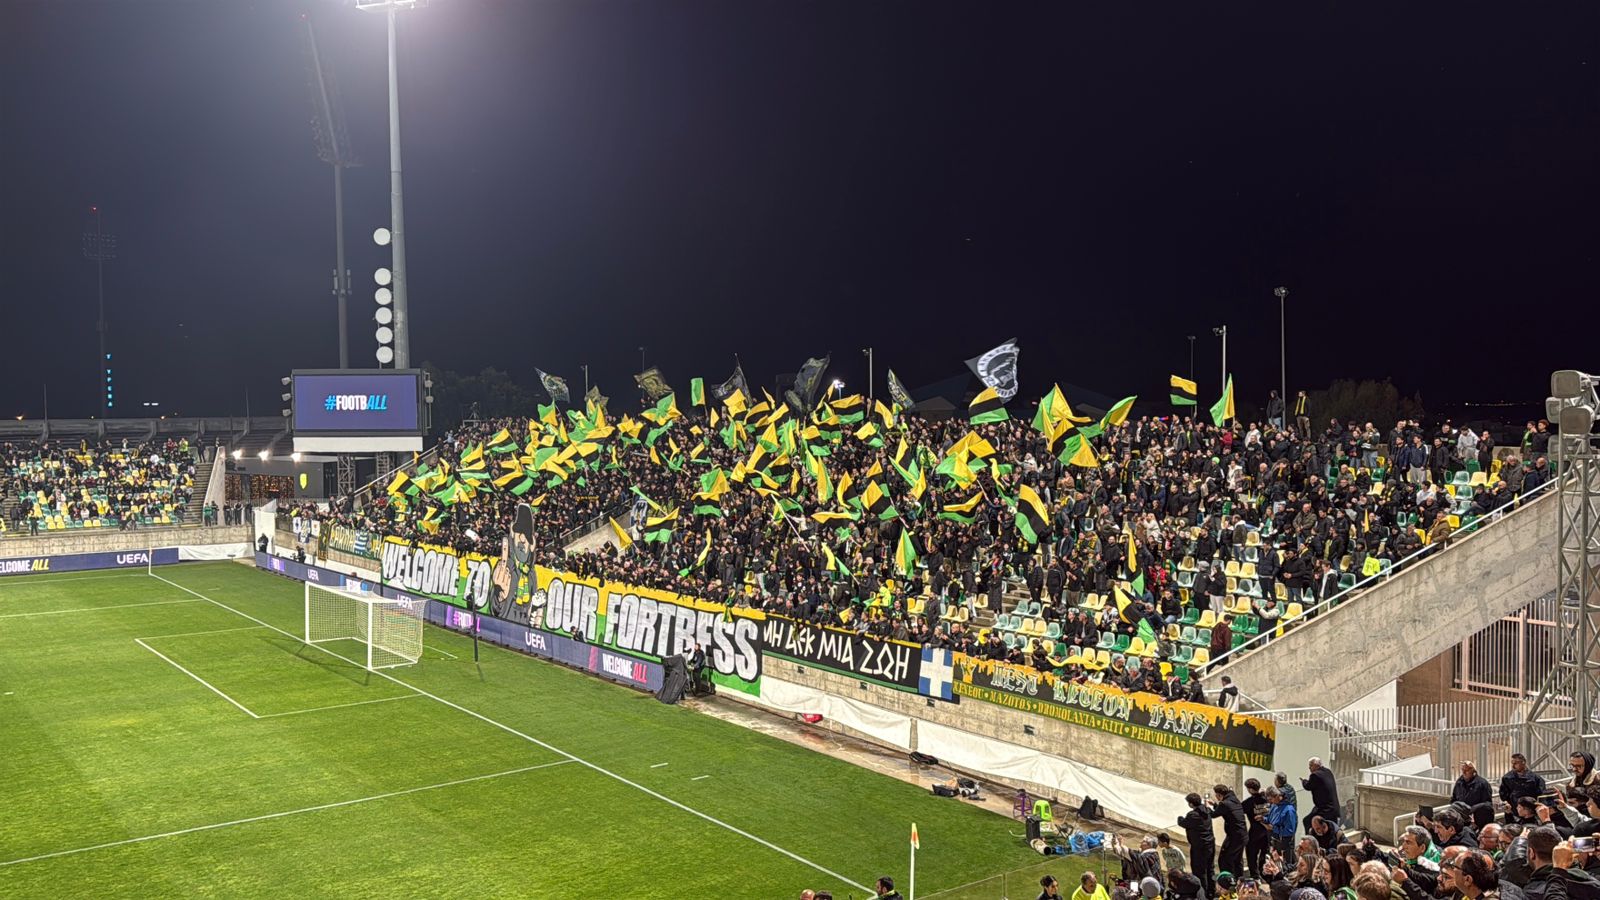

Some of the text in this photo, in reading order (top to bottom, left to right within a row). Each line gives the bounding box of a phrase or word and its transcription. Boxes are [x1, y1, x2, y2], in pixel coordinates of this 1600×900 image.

[324, 394, 387, 410] #FOOTBALL
[31, 559, 49, 571] ALL
[117, 553, 149, 564] UEFA
[382, 542, 759, 681] WELCOME TO OUR FORTRESS
[525, 631, 546, 651] UEFA
[602, 653, 648, 683] WELCOME ALL
[860, 640, 910, 681] ΖΩΗ
[1101, 719, 1124, 735] KITI
[1131, 726, 1180, 749] PERVOLIA
[1148, 704, 1210, 740] FANS
